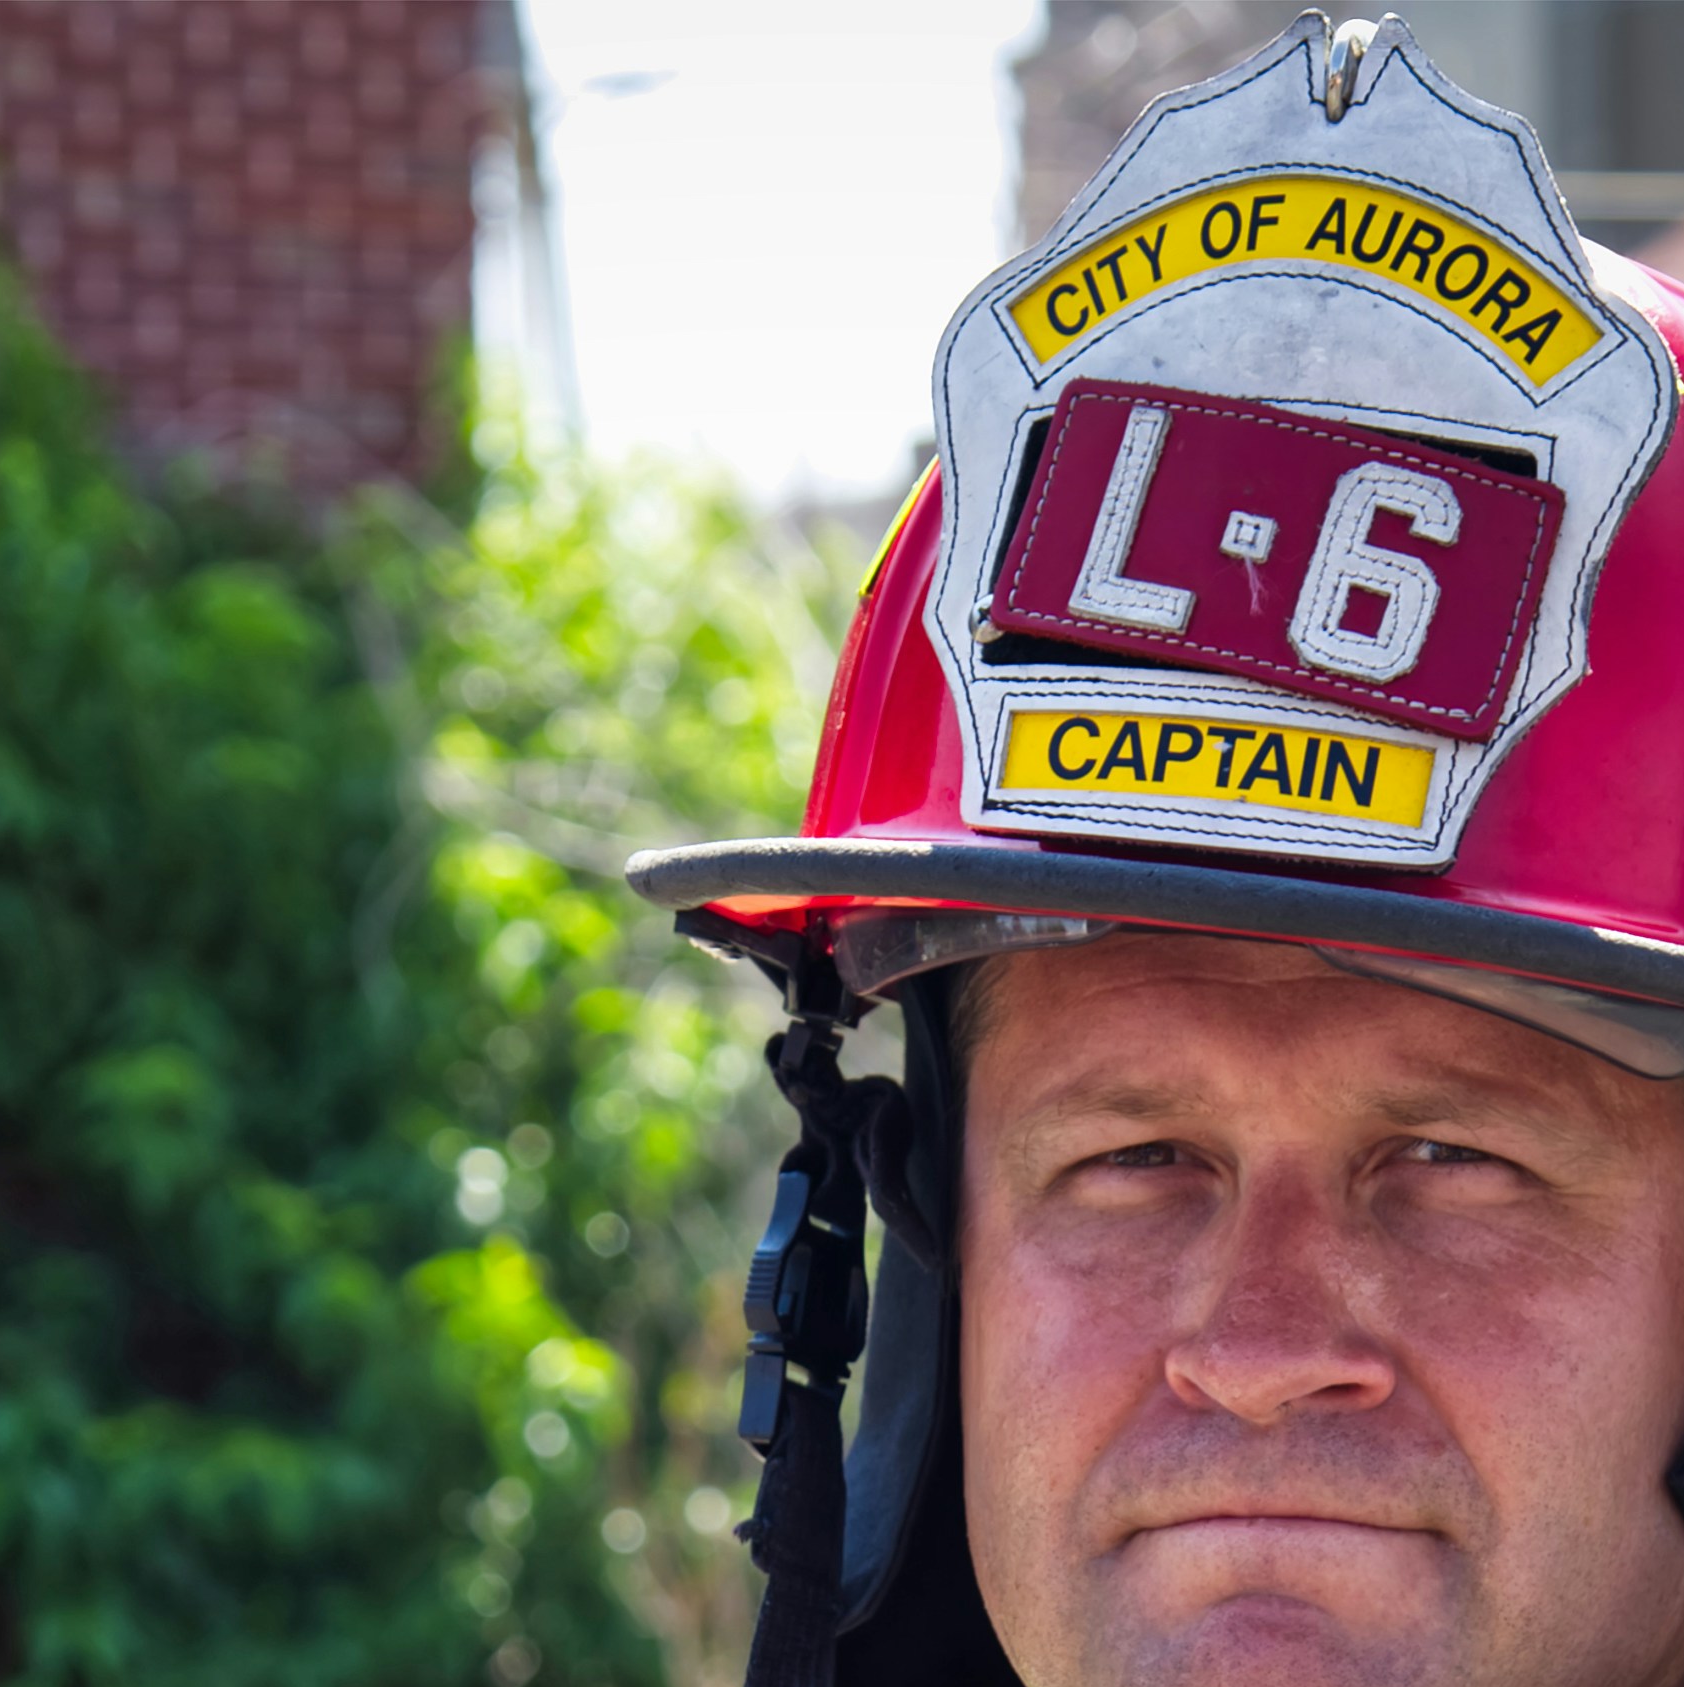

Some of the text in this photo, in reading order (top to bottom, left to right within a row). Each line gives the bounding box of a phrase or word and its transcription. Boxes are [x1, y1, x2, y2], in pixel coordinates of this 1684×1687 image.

[1045, 195, 1563, 366] CITY OF AURORA
[1047, 716, 1380, 807] CAPTAIN
